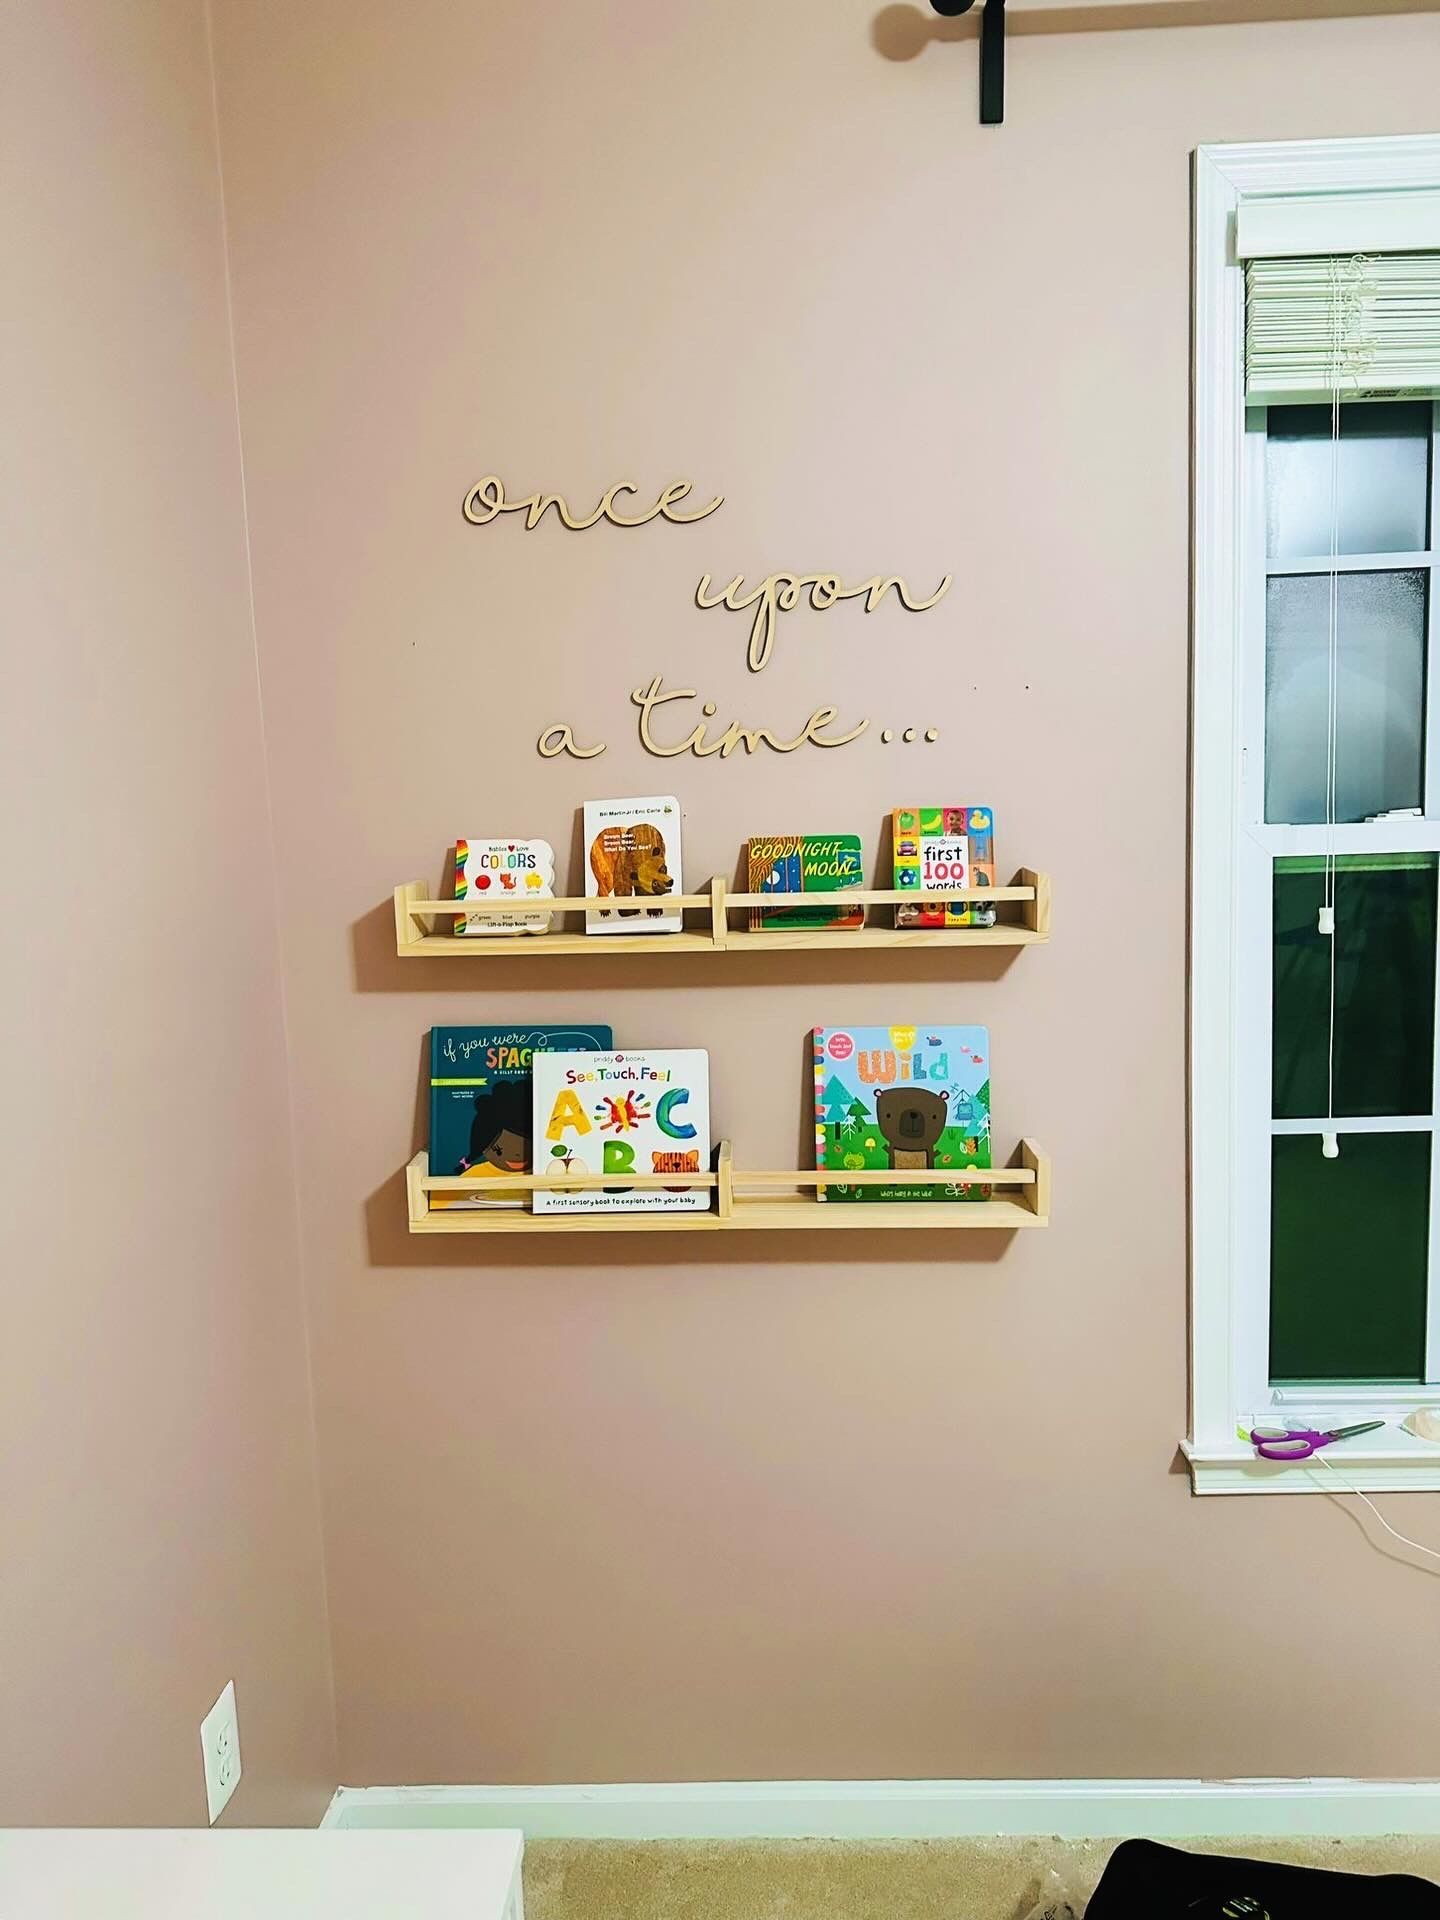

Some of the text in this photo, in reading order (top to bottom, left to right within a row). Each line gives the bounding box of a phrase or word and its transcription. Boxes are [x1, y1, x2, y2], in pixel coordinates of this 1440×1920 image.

[462, 476, 725, 530] once
[695, 572, 952, 672] upon
[537, 674, 940, 759] a time...
[750, 841, 842, 859] GOODNIGHT
[924, 846, 962, 861] first
[480, 854, 536, 870] COLORS
[804, 858, 854, 876] MOON
[924, 862, 964, 880] 100
[443, 1038, 456, 1063] if
[459, 1036, 489, 1058] you
[492, 1033, 529, 1046] were
[641, 1067, 671, 1082] Feel
[545, 1087, 698, 1142] A C
[552, 1198, 567, 1206] first
[621, 1198, 646, 1206] explore
[680, 1197, 696, 1205] baby
